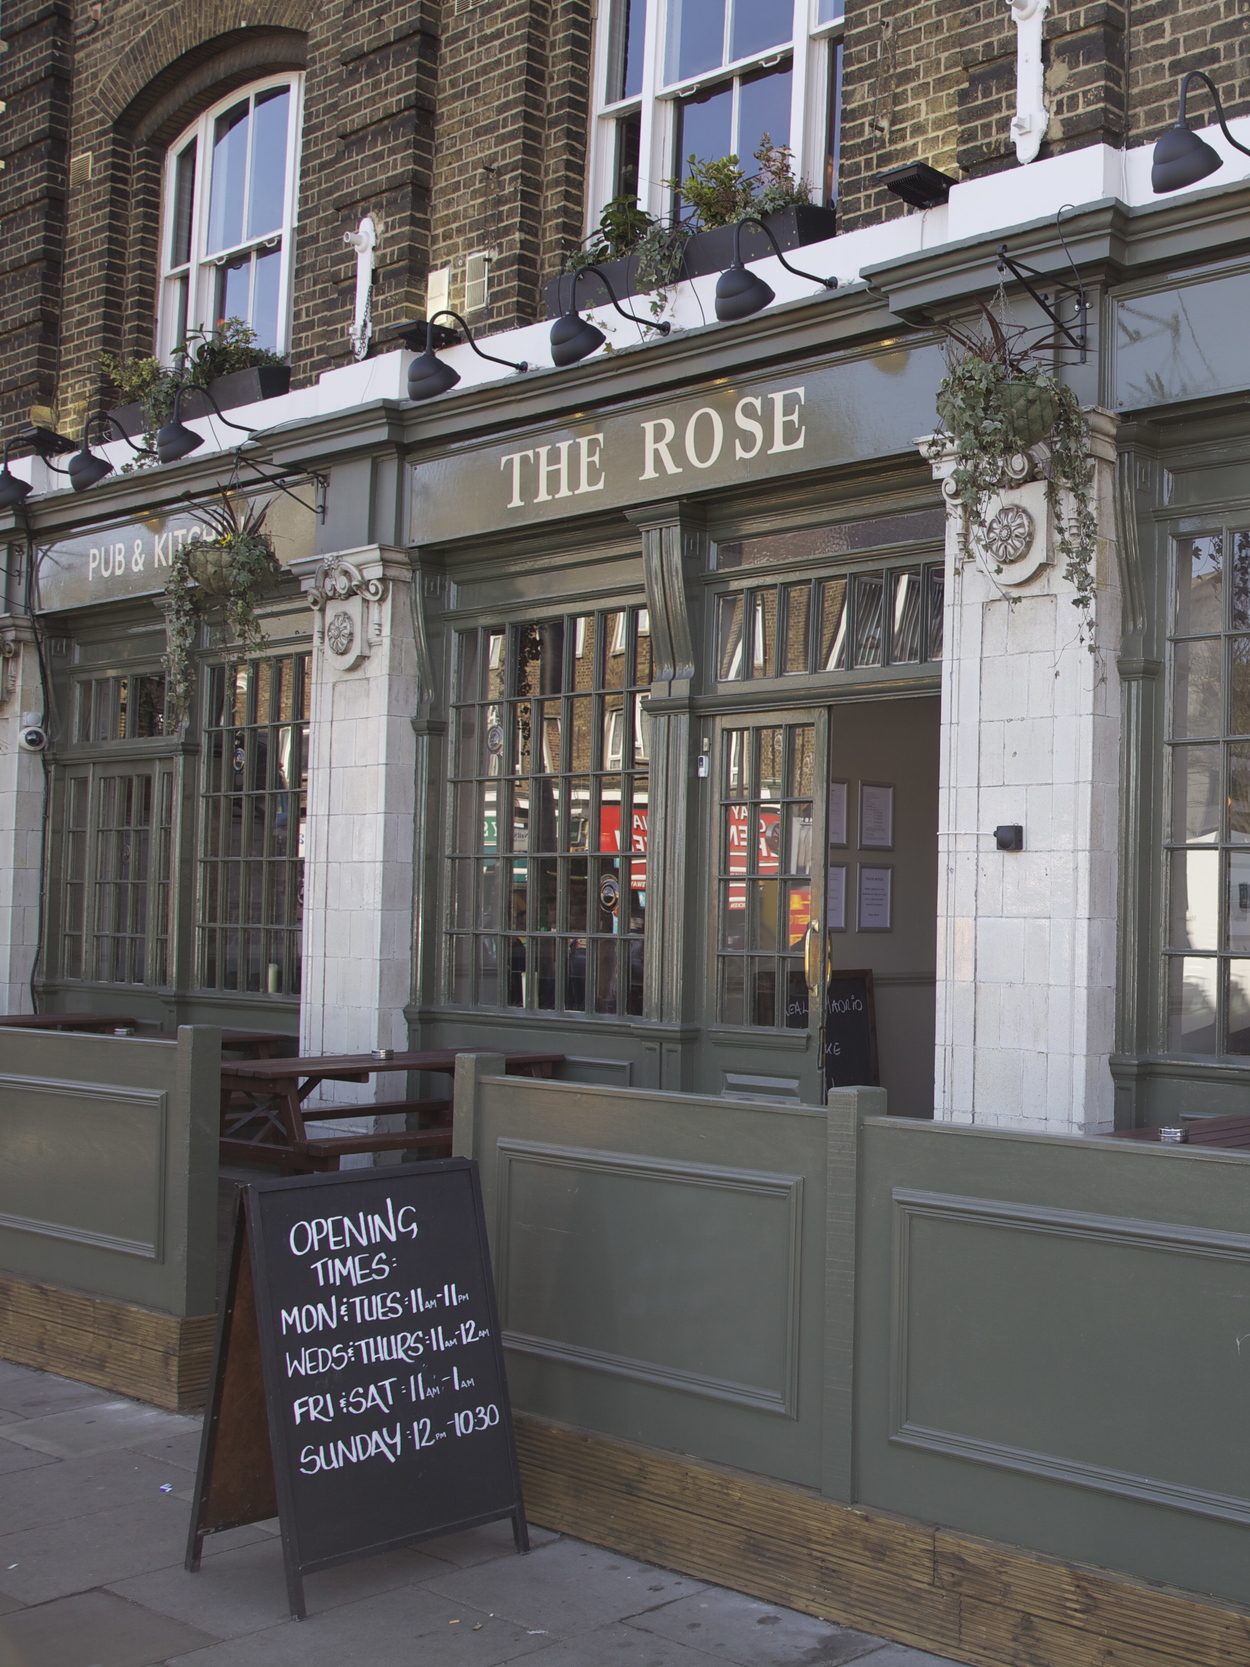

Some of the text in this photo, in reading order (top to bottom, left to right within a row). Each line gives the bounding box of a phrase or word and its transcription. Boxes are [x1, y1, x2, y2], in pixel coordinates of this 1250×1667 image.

[500, 386, 806, 509] THE ROSE
[88, 516, 246, 581] PUB & KITCH
[785, 1001, 809, 1017] EAL
[289, 1197, 418, 1256] OPENING
[310, 1252, 397, 1287] TIMES:
[281, 1295, 337, 1335] MON
[286, 1343, 348, 1378] WEDS
[293, 1393, 334, 1426] FRI
